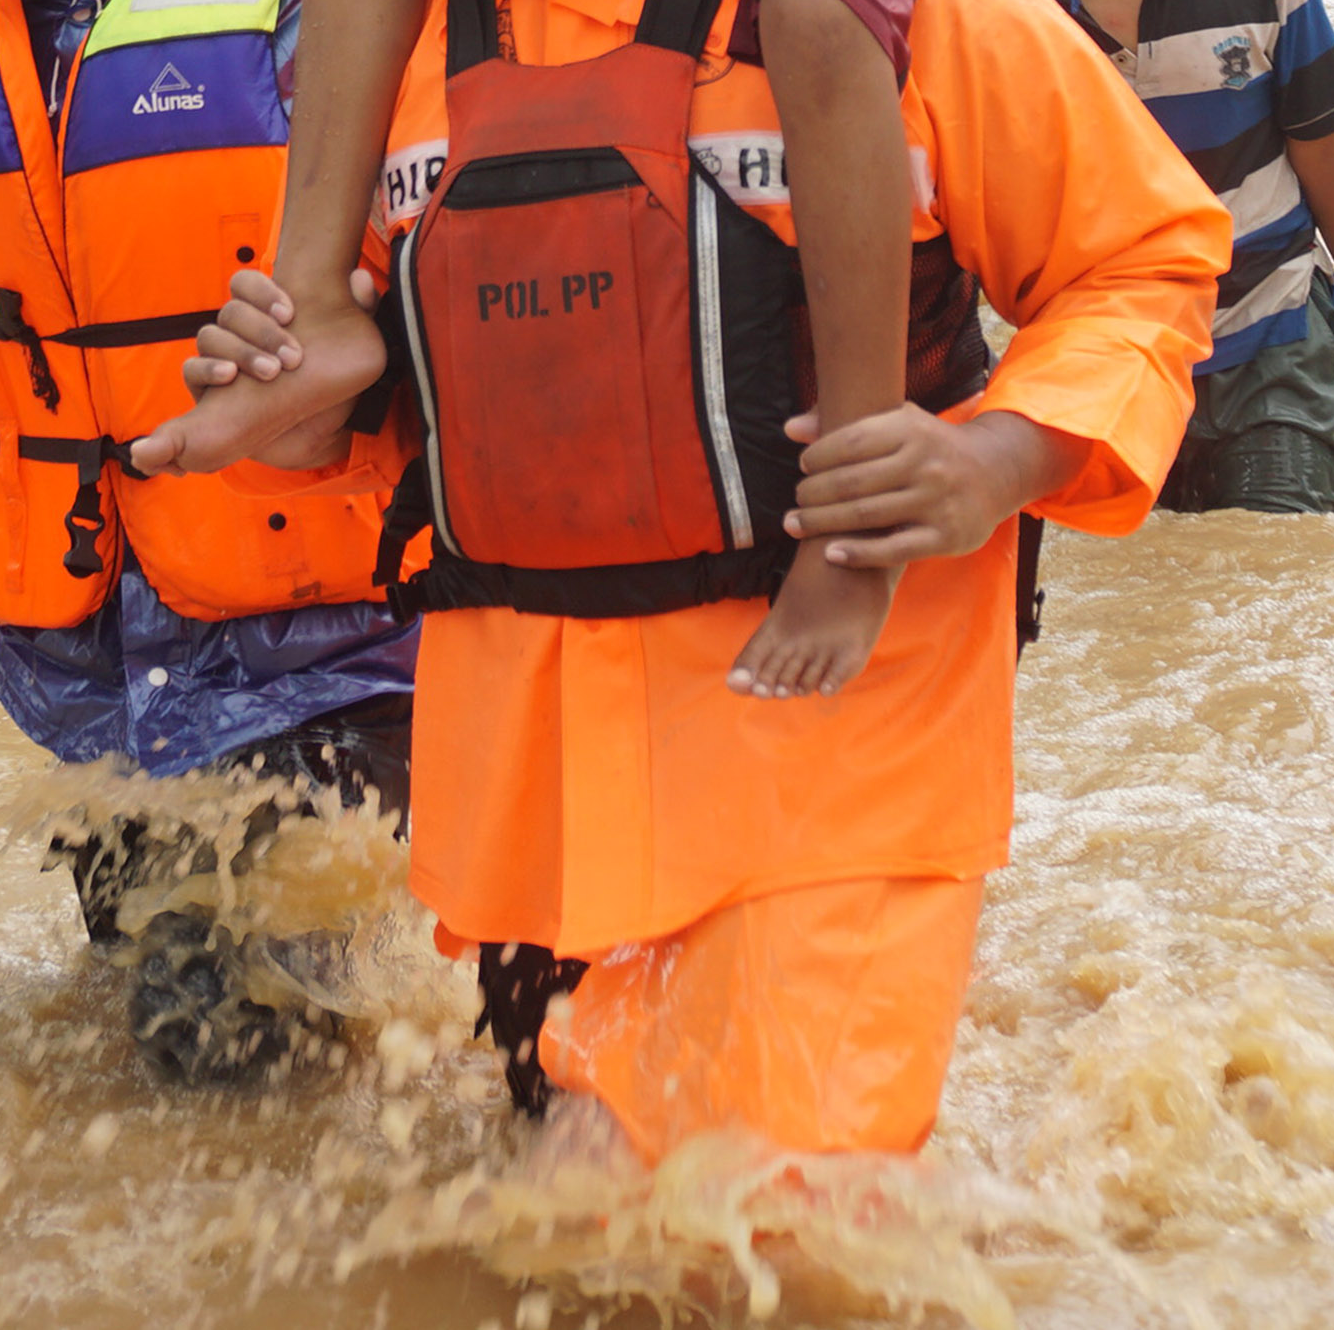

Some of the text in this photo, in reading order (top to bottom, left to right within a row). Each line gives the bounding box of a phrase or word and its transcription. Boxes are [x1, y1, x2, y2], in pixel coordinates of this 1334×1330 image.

[132, 91, 205, 115] Alunas
[478, 271, 614, 322] POL PP
